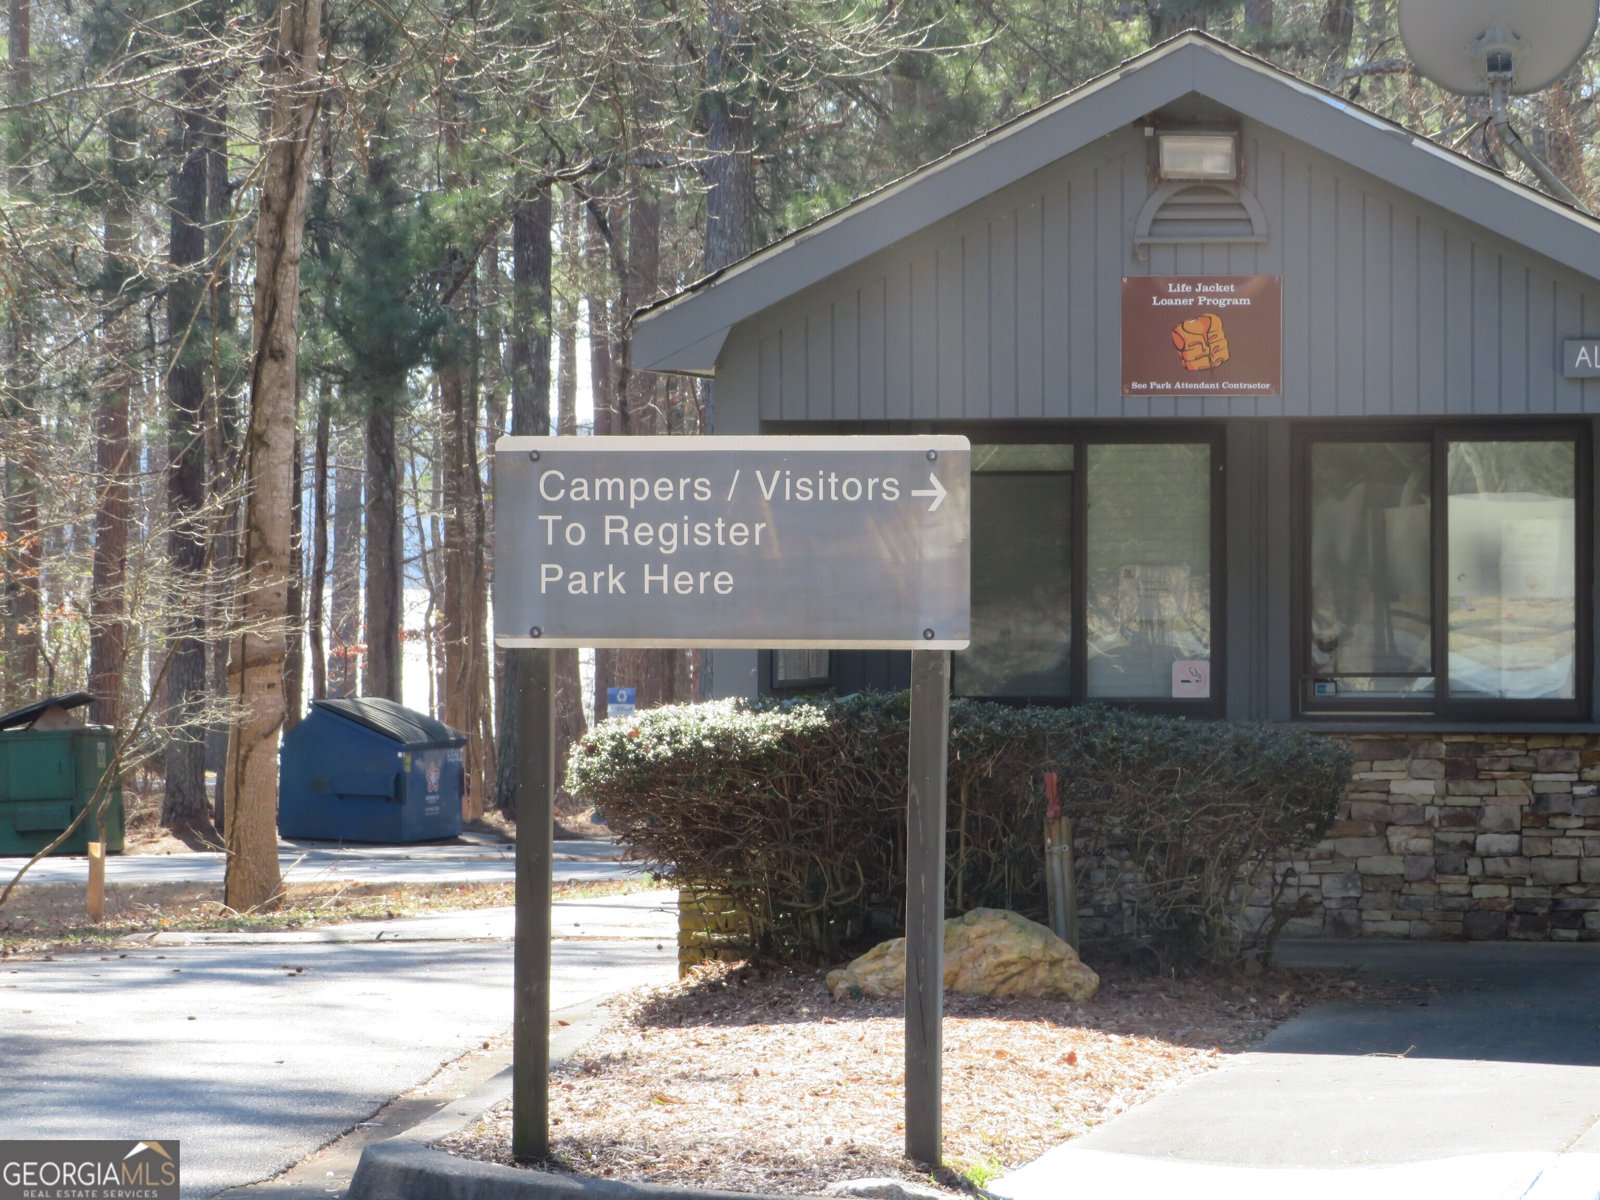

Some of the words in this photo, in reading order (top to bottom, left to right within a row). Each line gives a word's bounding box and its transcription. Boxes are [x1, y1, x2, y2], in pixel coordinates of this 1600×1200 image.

[1168, 283, 1192, 293] Life
[1195, 283, 1235, 293] Jacket
[1152, 296, 1194, 306] Loaner
[1198, 296, 1250, 307] Program
[1131, 381, 1147, 390] See
[1150, 381, 1171, 390] Park
[1174, 381, 1219, 390] Attendant
[1222, 381, 1270, 390] Contractor
[538, 470, 713, 508] Campers
[727, 469, 740, 502] /
[755, 470, 901, 502] Visitors
[538, 514, 587, 547] To
[604, 514, 767, 554] Register
[540, 563, 627, 595] Park
[643, 563, 735, 595] Here
